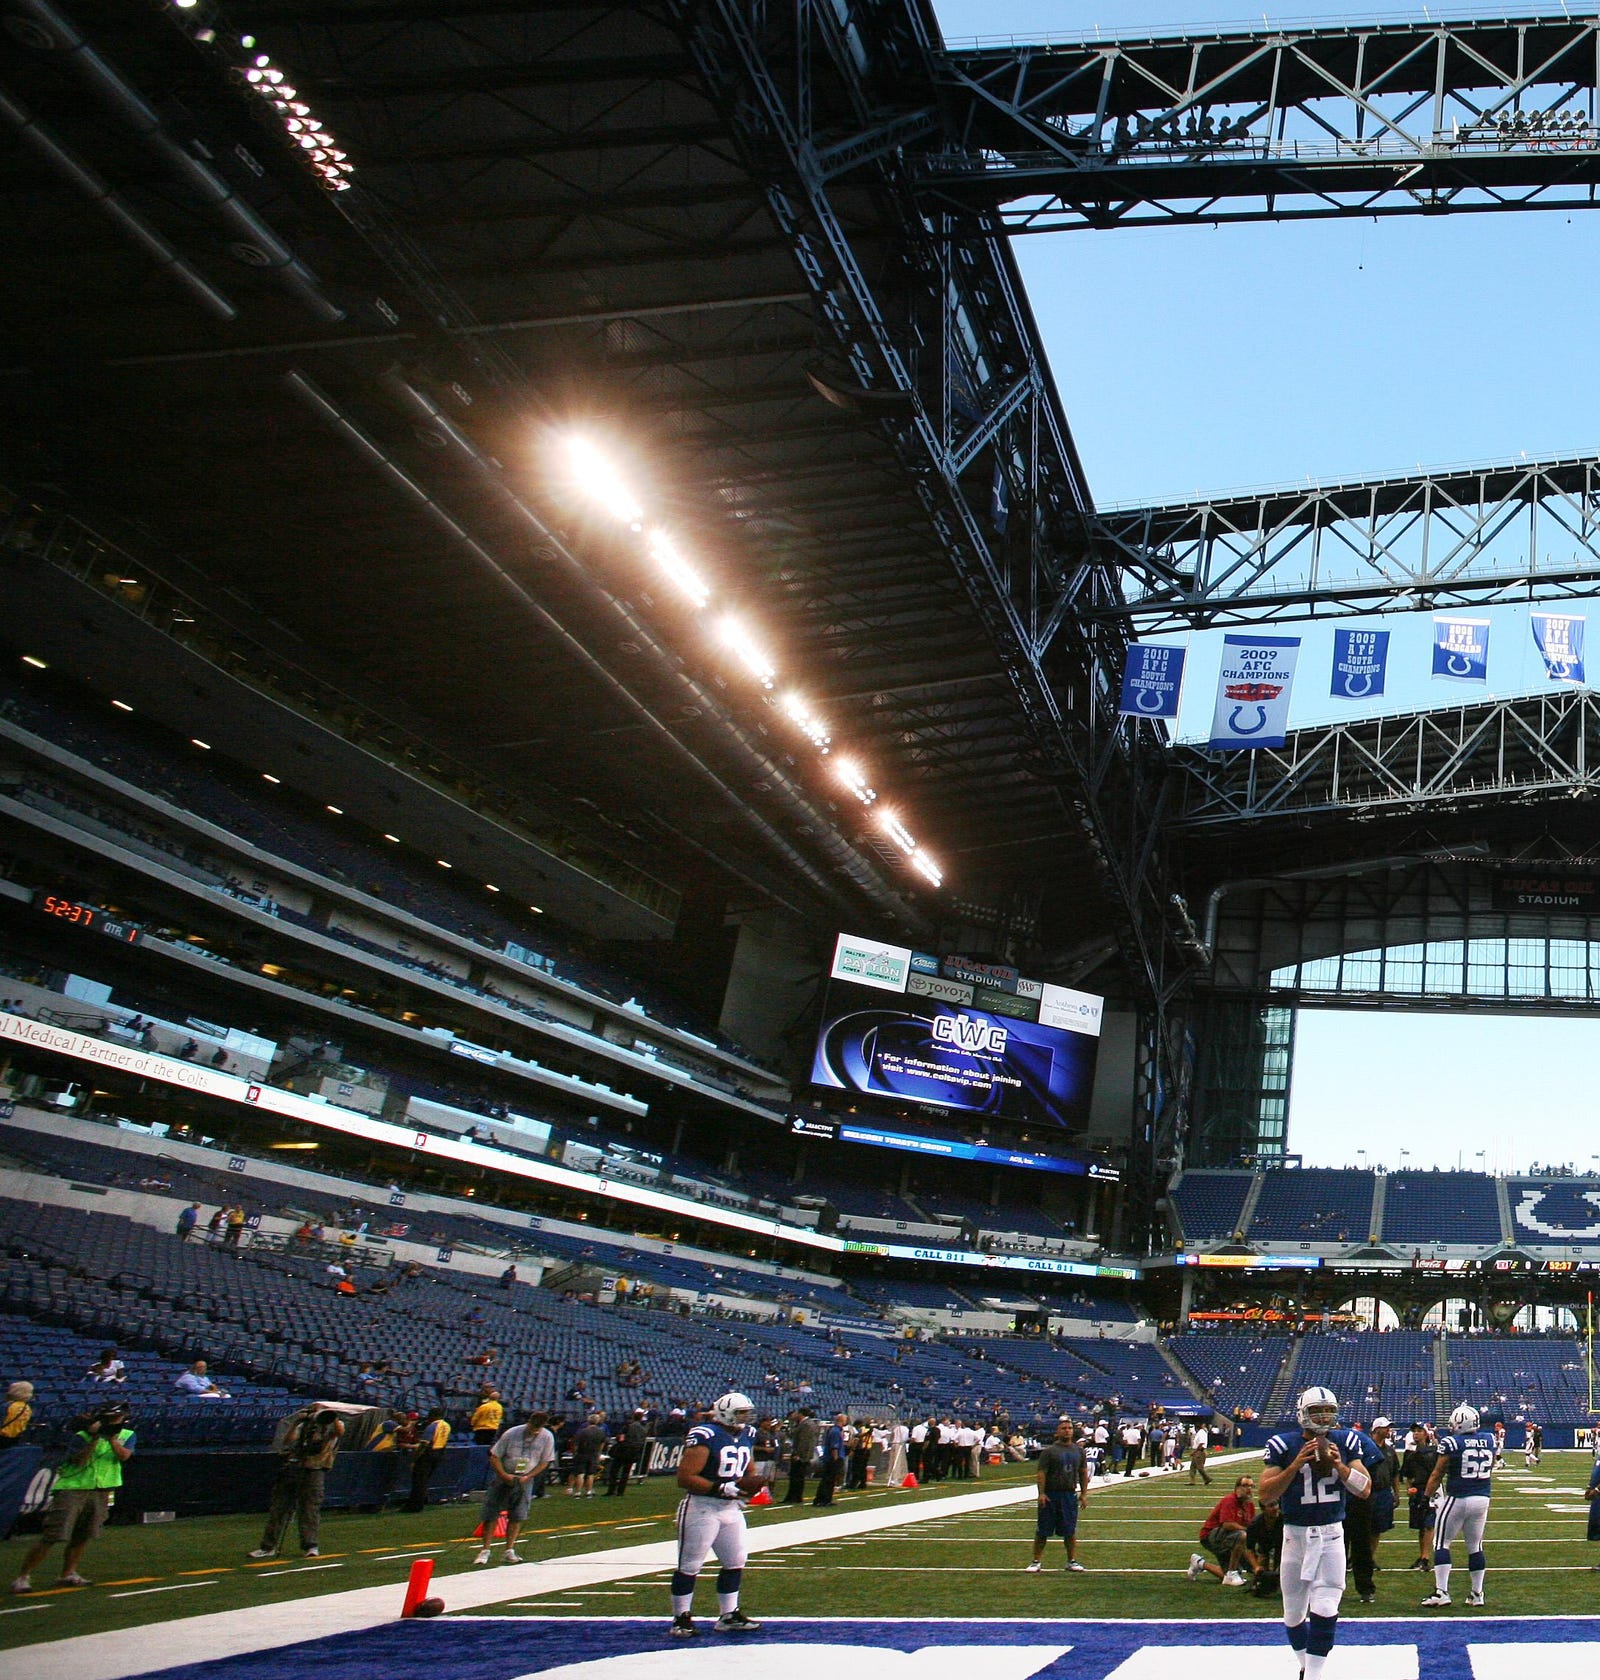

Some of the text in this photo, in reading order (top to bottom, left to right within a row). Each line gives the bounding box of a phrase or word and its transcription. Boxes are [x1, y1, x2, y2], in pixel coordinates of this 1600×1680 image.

[1349, 632, 1376, 643] 2009
[1142, 647, 1170, 661] 2010
[1239, 649, 1278, 660] 2009
[1348, 643, 1375, 654] AFC
[1142, 659, 1168, 671] AFC
[1242, 661, 1272, 671] AFC
[1347, 655, 1373, 665] SOUTH
[1222, 669, 1290, 680] CHAMPIONS
[1337, 663, 1381, 674] CHAMPIONS
[1140, 671, 1166, 682] SOUTH
[1130, 679, 1174, 691] CHAMPIONS
[1517, 894, 1579, 905] STADIUM
[44, 896, 95, 926] 52:37
[127, 929, 138, 942] 1
[845, 950, 866, 958] WALTER
[842, 965, 860, 974] POWER
[843, 957, 900, 977] PAYTON
[944, 955, 989, 975] LUCAS
[955, 970, 1002, 988] STADIUM
[928, 982, 971, 1000] TOYOTA
[932, 1014, 1008, 1054] CWC
[11, 1020, 76, 1052] Medical
[80, 1039, 132, 1066] Partner
[134, 1056, 150, 1071] of
[153, 1063, 174, 1078] the
[177, 1067, 209, 1089] Colts
[882, 1063, 992, 1089] visit www.coltsvip.com
[884, 1053, 1022, 1087] For information about joining
[842, 1130, 883, 1143] WELCOME
[920, 1140, 952, 1153] GROUPS
[229, 1159, 245, 1171] 241
[914, 1249, 966, 1262] CALL 811
[1028, 1260, 1074, 1273] CALL 811
[1549, 1261, 1572, 1271] 52:37
[1464, 1438, 1488, 1448] SHIPLEY
[718, 1445, 751, 1478] 60
[1461, 1449, 1493, 1478] 62
[1300, 1462, 1341, 1505] 12
